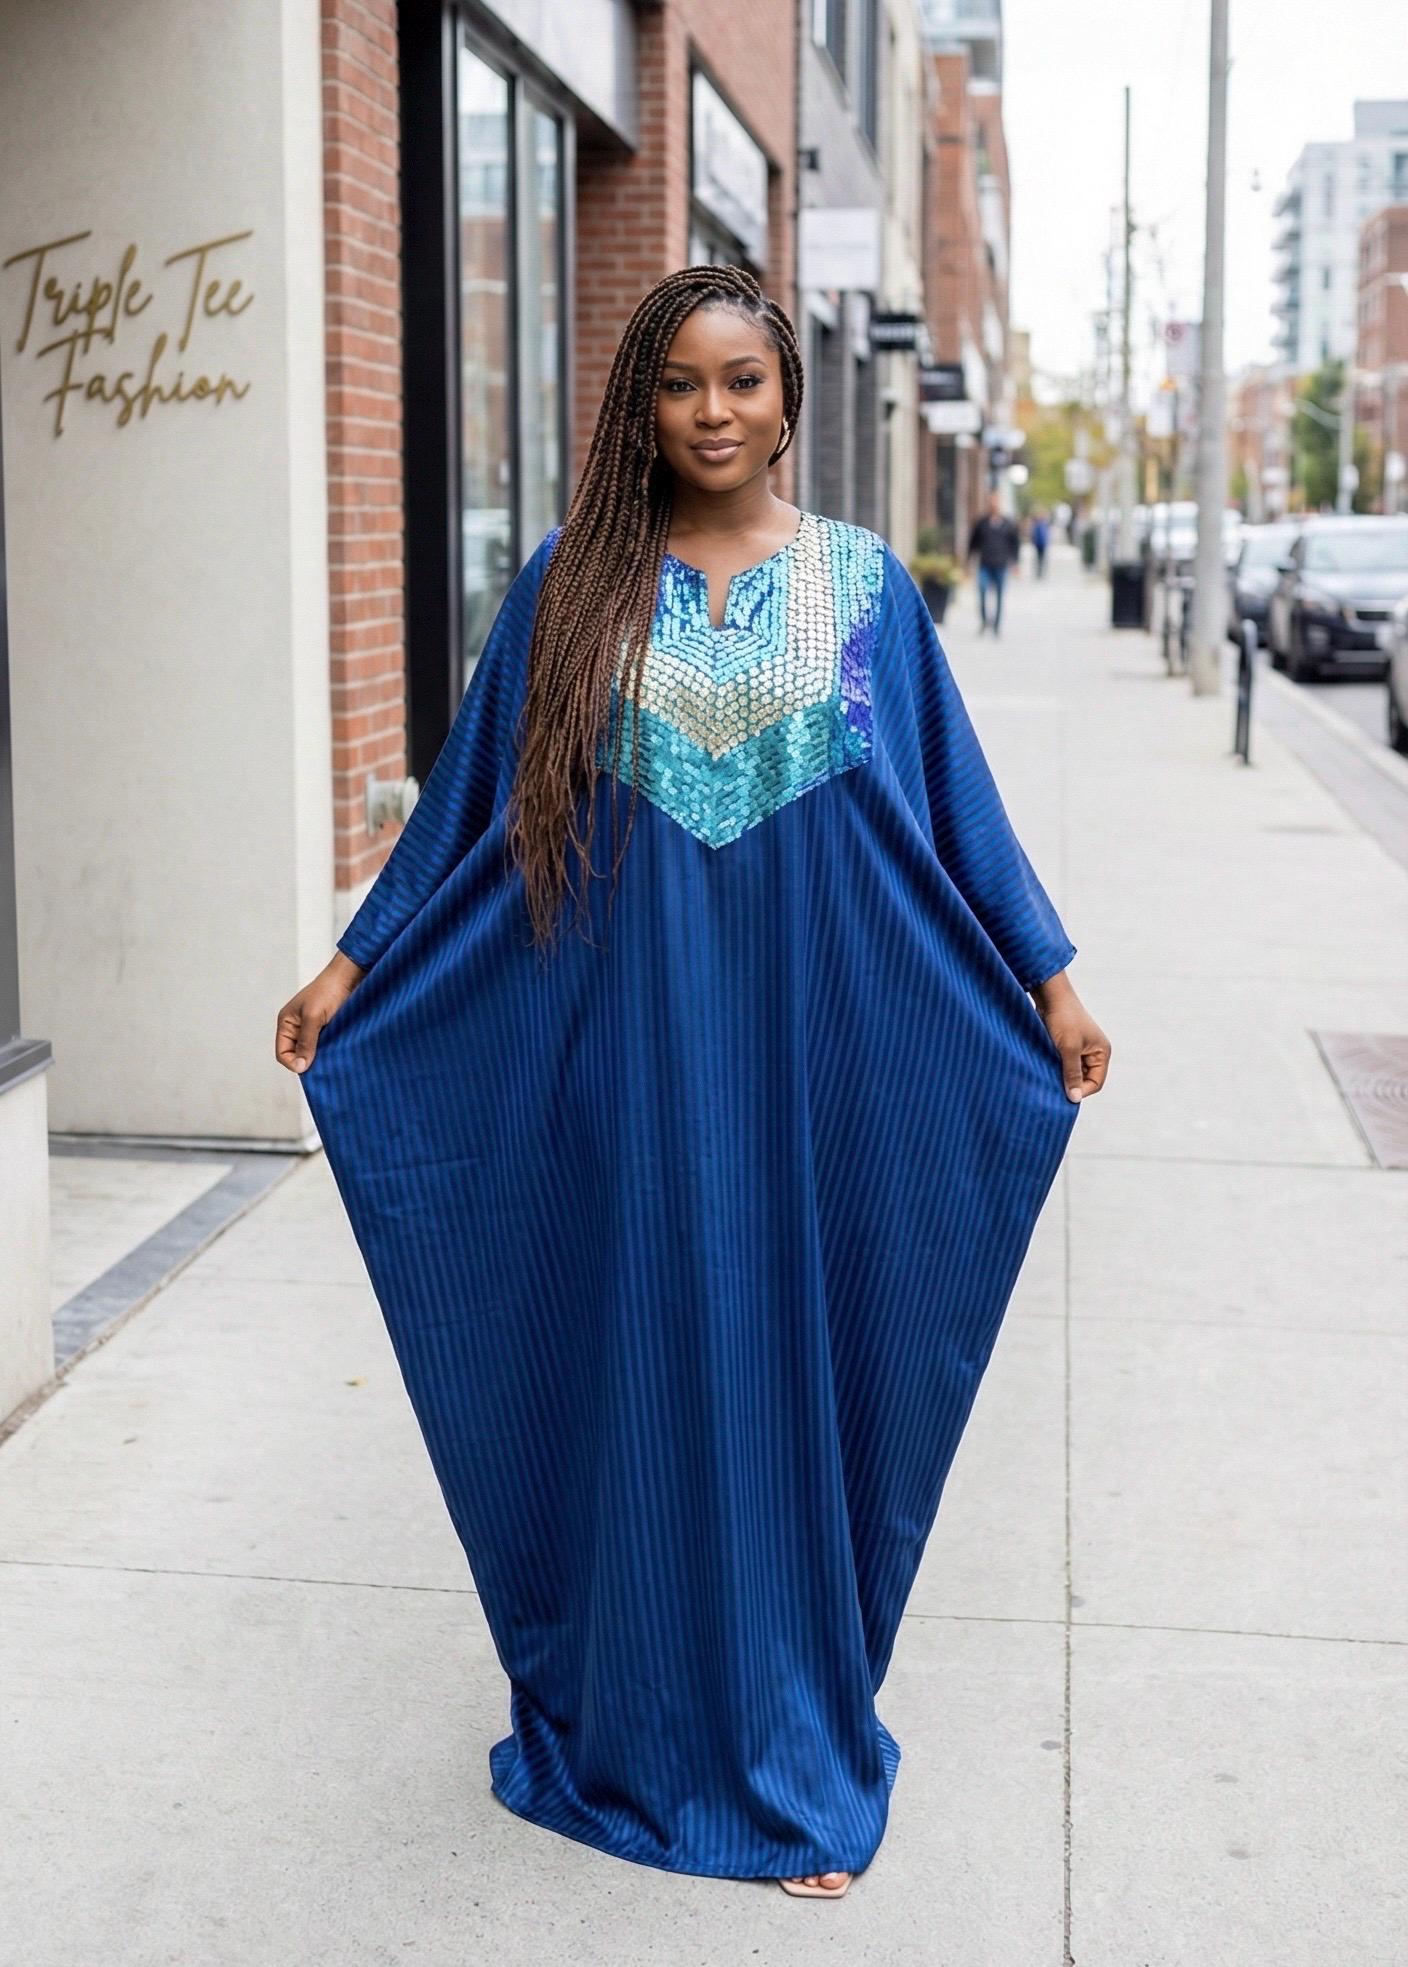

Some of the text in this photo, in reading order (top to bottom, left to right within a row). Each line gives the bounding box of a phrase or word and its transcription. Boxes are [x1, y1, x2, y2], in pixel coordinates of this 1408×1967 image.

[3, 230, 254, 355] Triple Tee
[35, 328, 251, 439] Fashion
